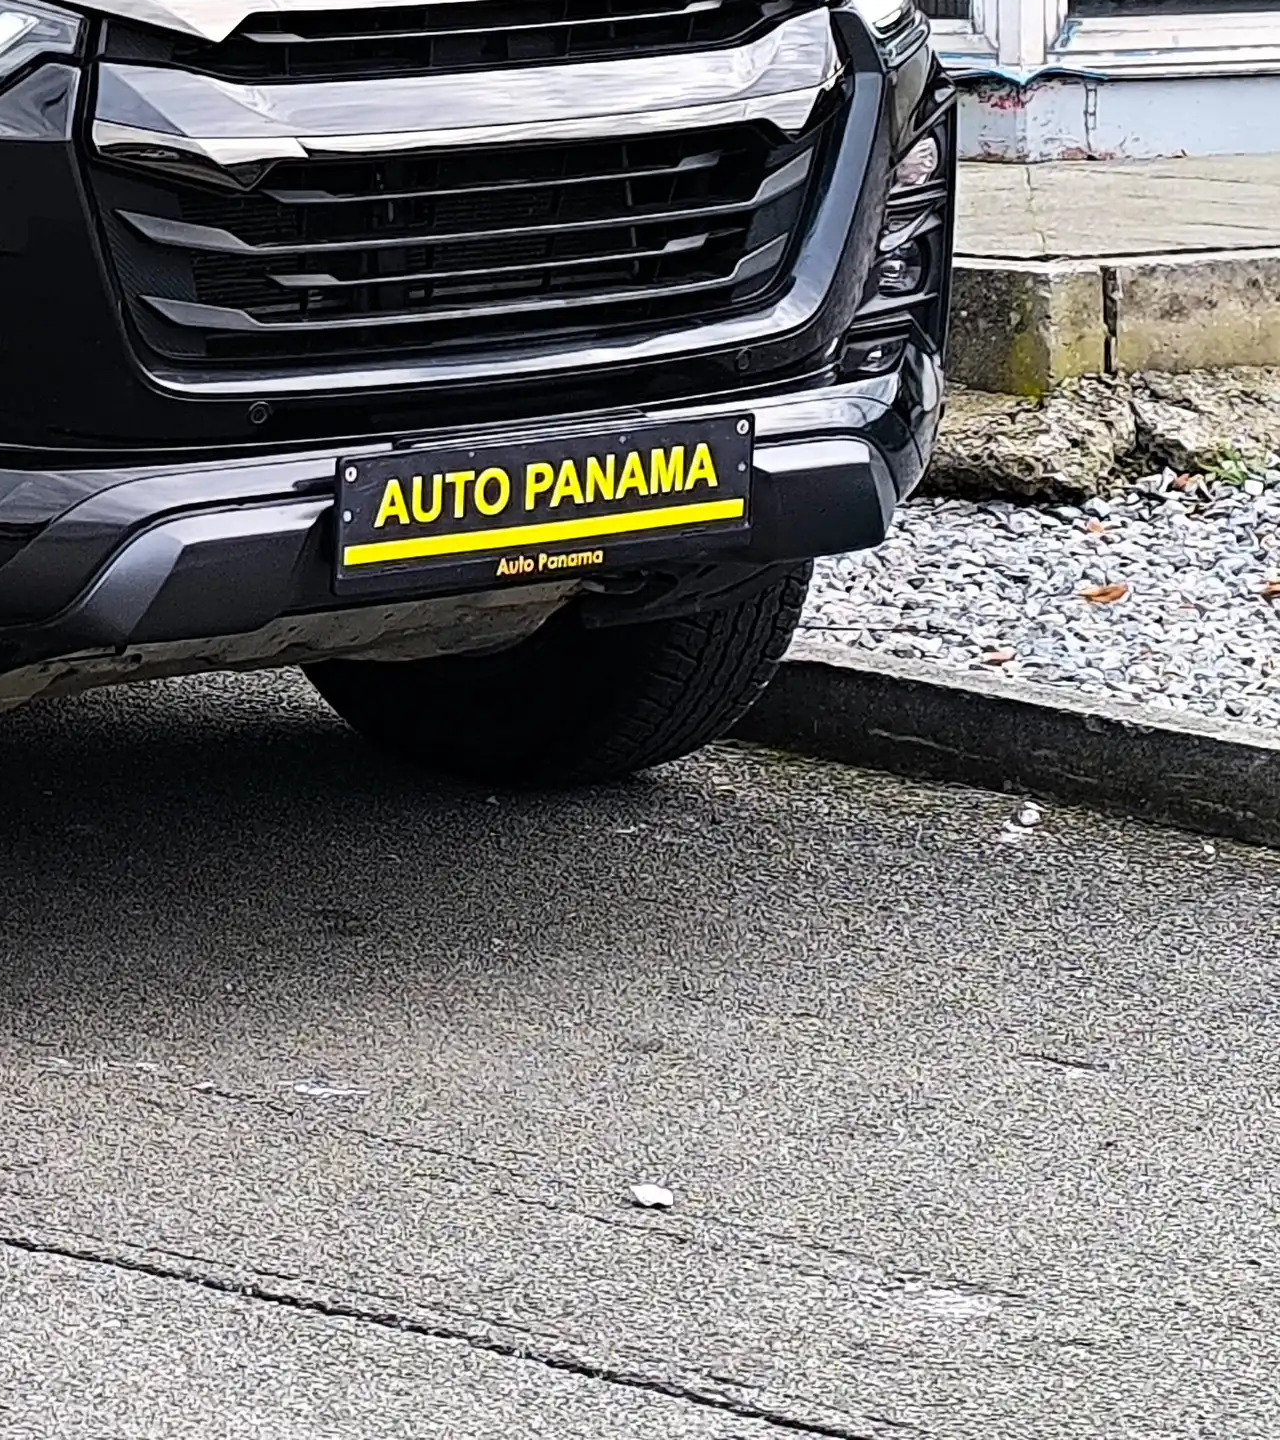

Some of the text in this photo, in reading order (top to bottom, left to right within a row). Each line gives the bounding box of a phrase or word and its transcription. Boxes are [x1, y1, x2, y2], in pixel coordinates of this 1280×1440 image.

[373, 442, 718, 528] AUTO PANAMA
[496, 547, 604, 577] Auto Panama
